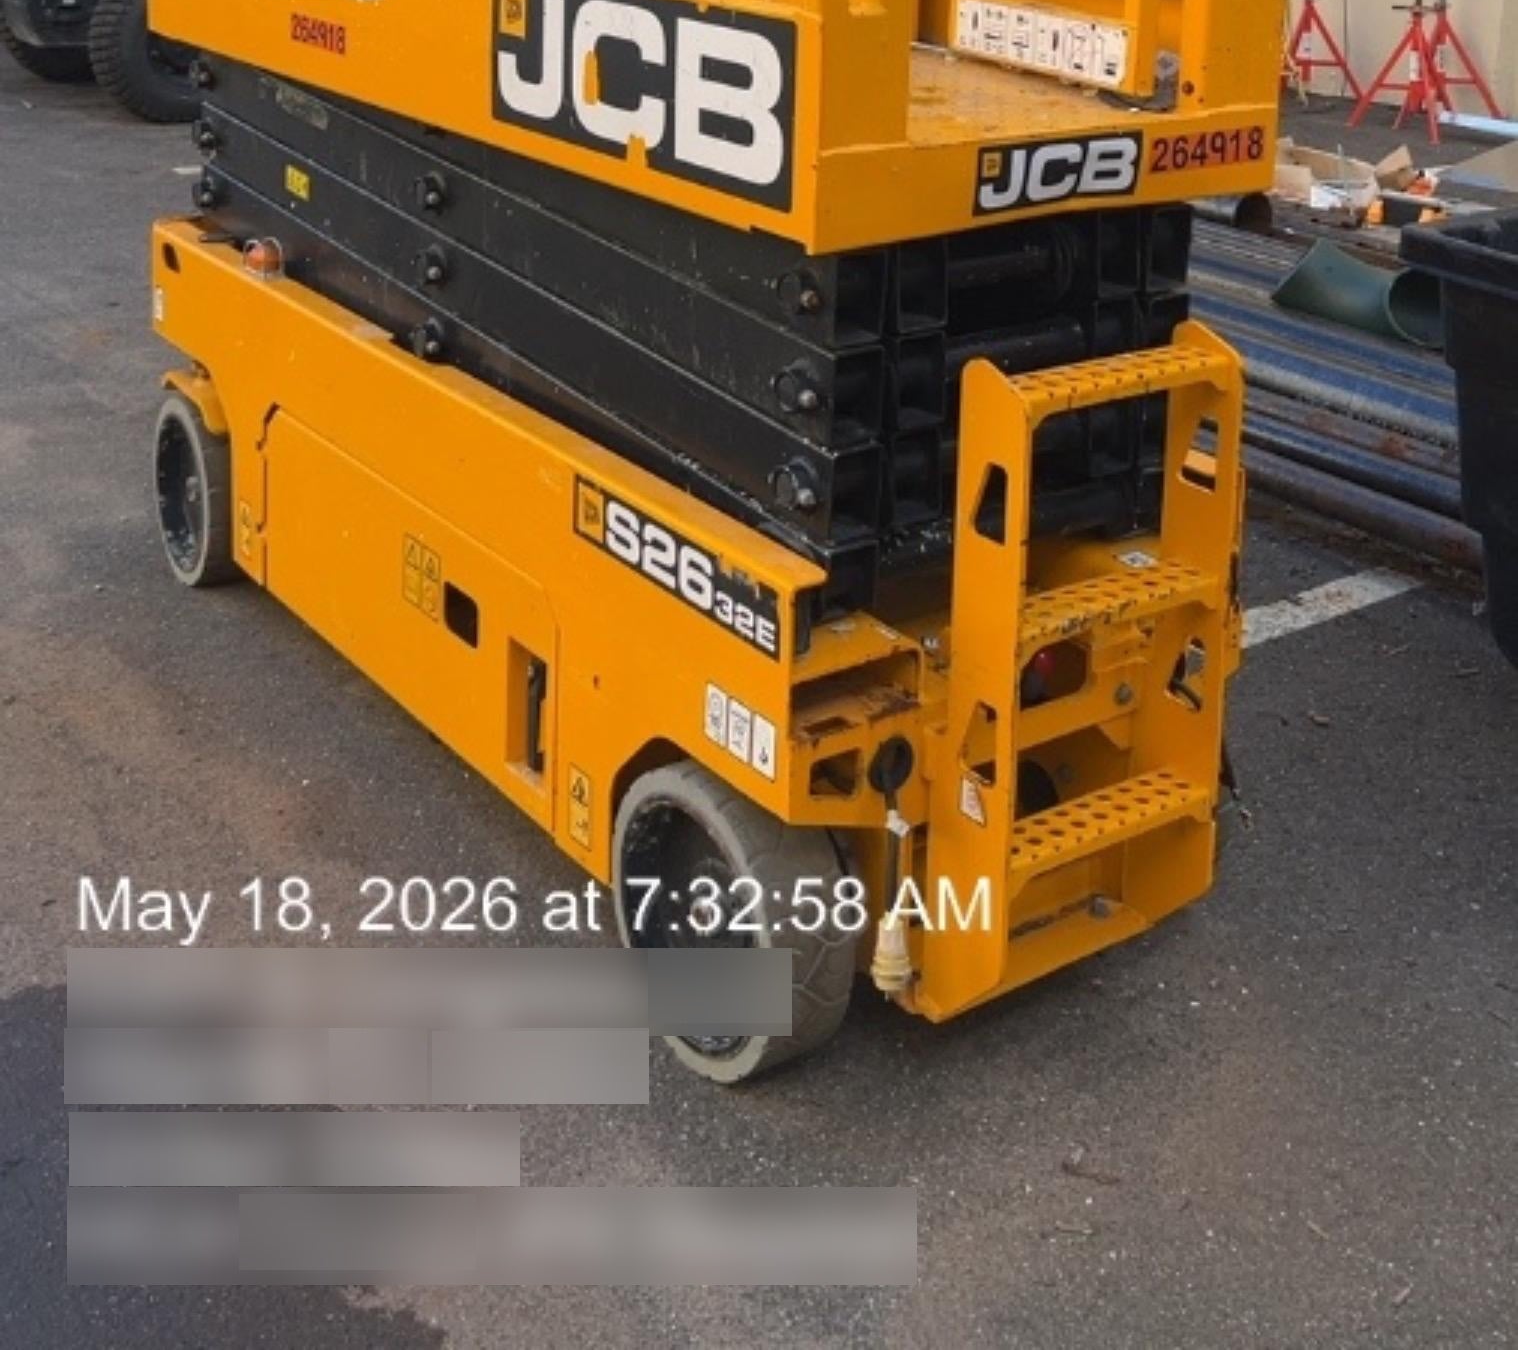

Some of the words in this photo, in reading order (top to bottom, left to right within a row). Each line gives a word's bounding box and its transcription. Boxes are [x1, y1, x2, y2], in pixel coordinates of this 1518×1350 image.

[290, 13, 346, 55] 264918
[979, 137, 1138, 210] JCB
[1152, 127, 1264, 172] 264918
